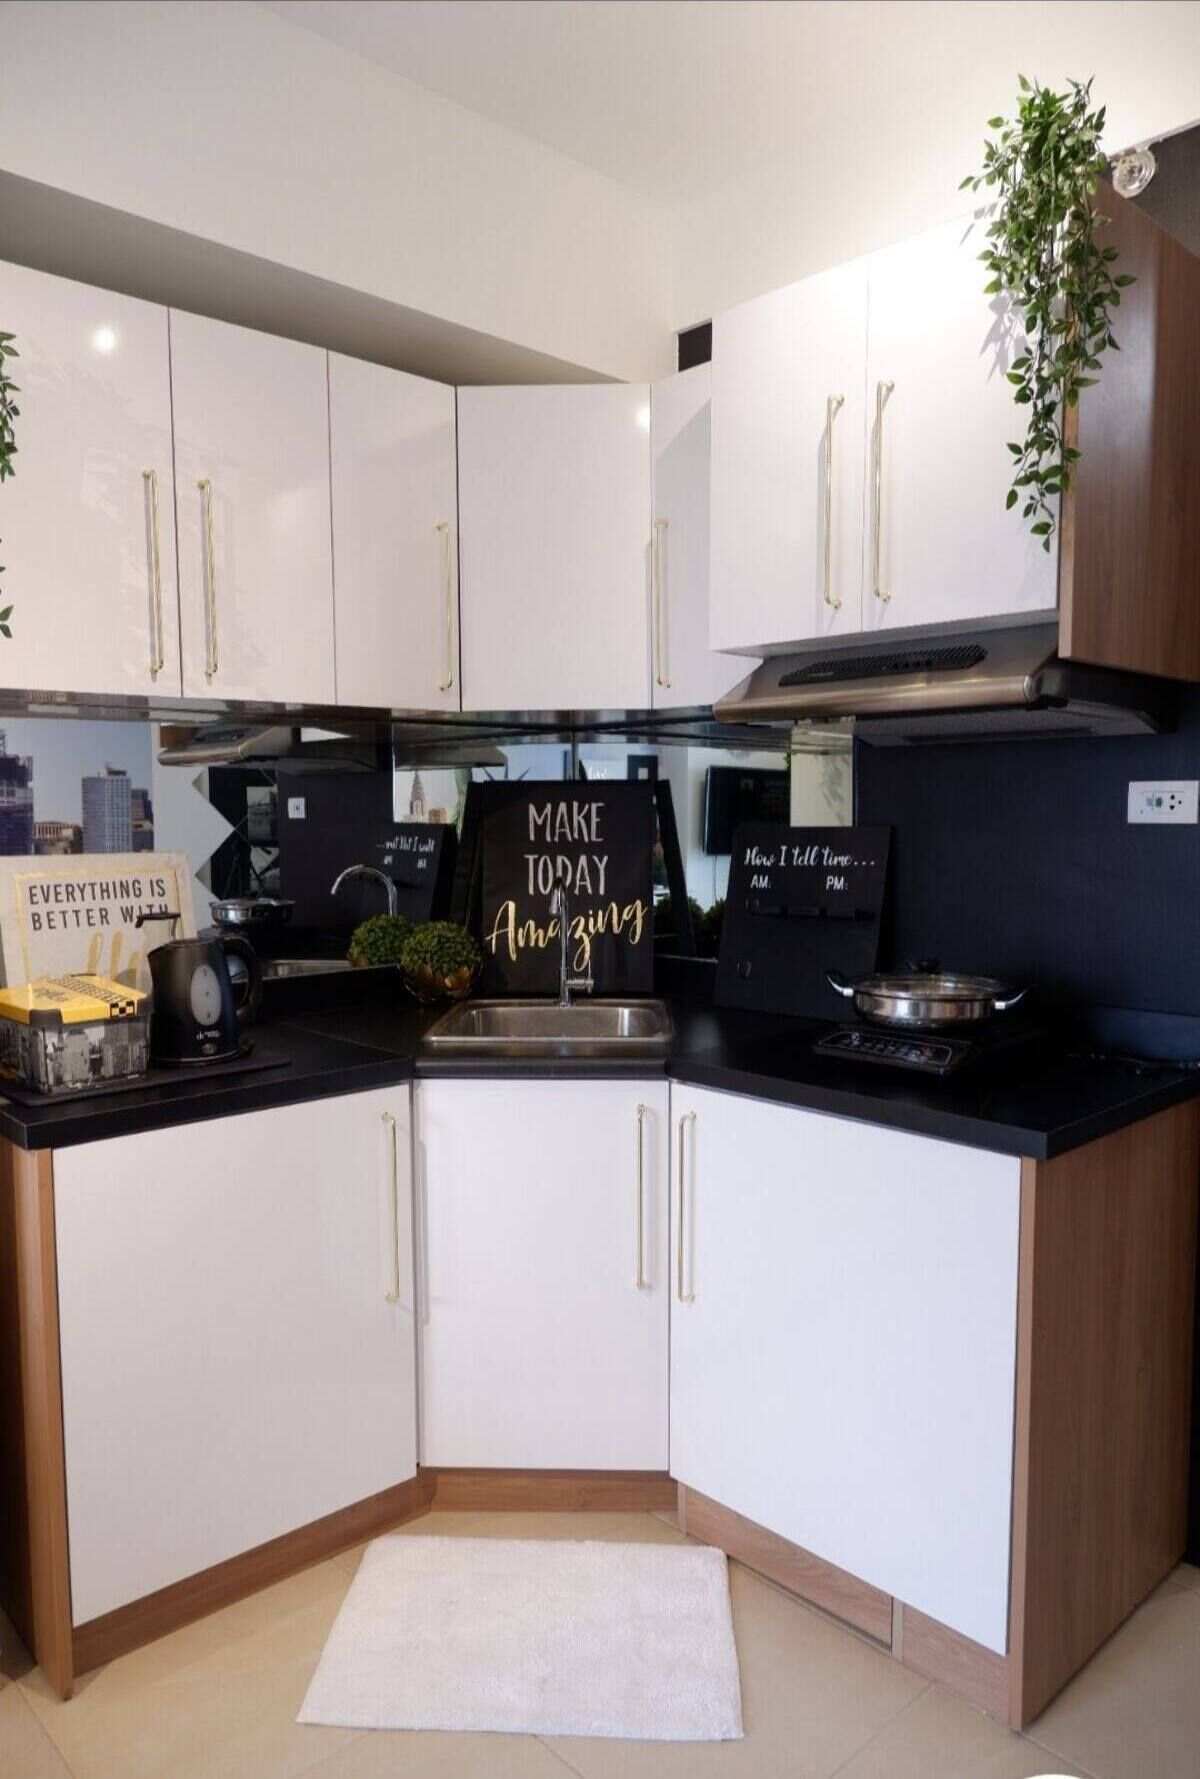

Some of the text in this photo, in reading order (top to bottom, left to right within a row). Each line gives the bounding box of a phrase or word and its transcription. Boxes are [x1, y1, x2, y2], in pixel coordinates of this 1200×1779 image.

[528, 801, 605, 843] MAKE
[744, 846, 776, 867] How
[778, 845, 787, 867] I
[792, 845, 819, 867] tell
[28, 879, 166, 905] EVERYTHING IS
[524, 854, 609, 896] TODAY
[31, 907, 110, 931] BETTER
[485, 899, 648, 972] Amazing
